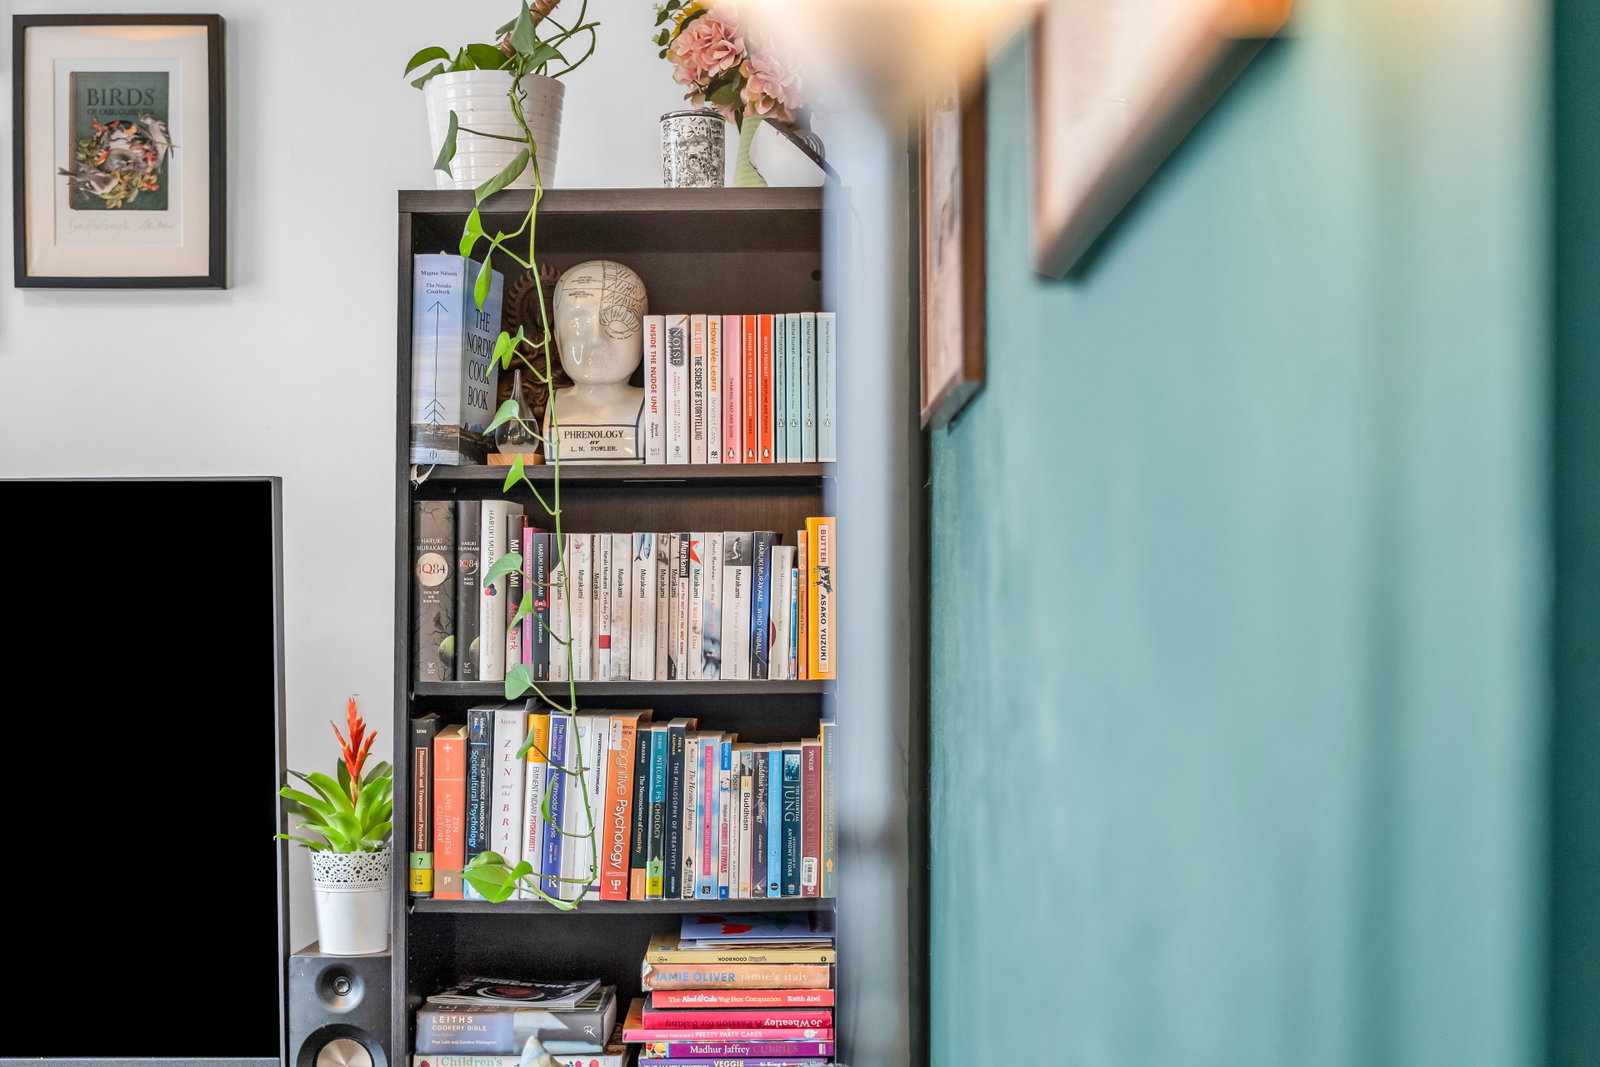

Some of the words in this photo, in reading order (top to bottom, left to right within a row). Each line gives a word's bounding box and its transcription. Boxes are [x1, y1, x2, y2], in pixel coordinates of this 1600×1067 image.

[87, 88, 155, 106] BIRDS
[475, 309, 490, 333] THE
[710, 322, 718, 344] How
[672, 328, 681, 364] NOISE
[710, 349, 718, 362] We
[467, 387, 488, 410] BOOK
[564, 430, 624, 439] PHRENOLOGY
[680, 540, 688, 576] Murakami
[509, 630, 518, 650] Dark
[556, 735, 564, 761] Routledge
[471, 750, 479, 801] Sociocultural
[616, 738, 632, 795] Cognitive
[531, 766, 540, 792] EMINENT
[732, 774, 740, 792] Book
[530, 793, 538, 815] INDIAN
[637, 786, 645, 821] Neuroscience
[653, 791, 662, 839] PSYCHOLOGY
[742, 792, 750, 831] Buddhism
[757, 788, 765, 824] Psychology
[783, 785, 795, 822] JUNG
[468, 804, 479, 848] Psychology
[671, 820, 677, 830] OF
[686, 808, 694, 831] Journey
[479, 832, 484, 840] OF
[528, 815, 537, 852] PSYCHOLOGISTS
[610, 800, 628, 869] Psychology
[655, 973, 688, 982] JAMIE
[693, 973, 735, 982] OLIVER
[765, 1017, 809, 1027] Wheatley
[441, 1057, 502, 1066] Children's
[690, 1045, 721, 1054] Madhur
[724, 1045, 749, 1055] Jaffrey
